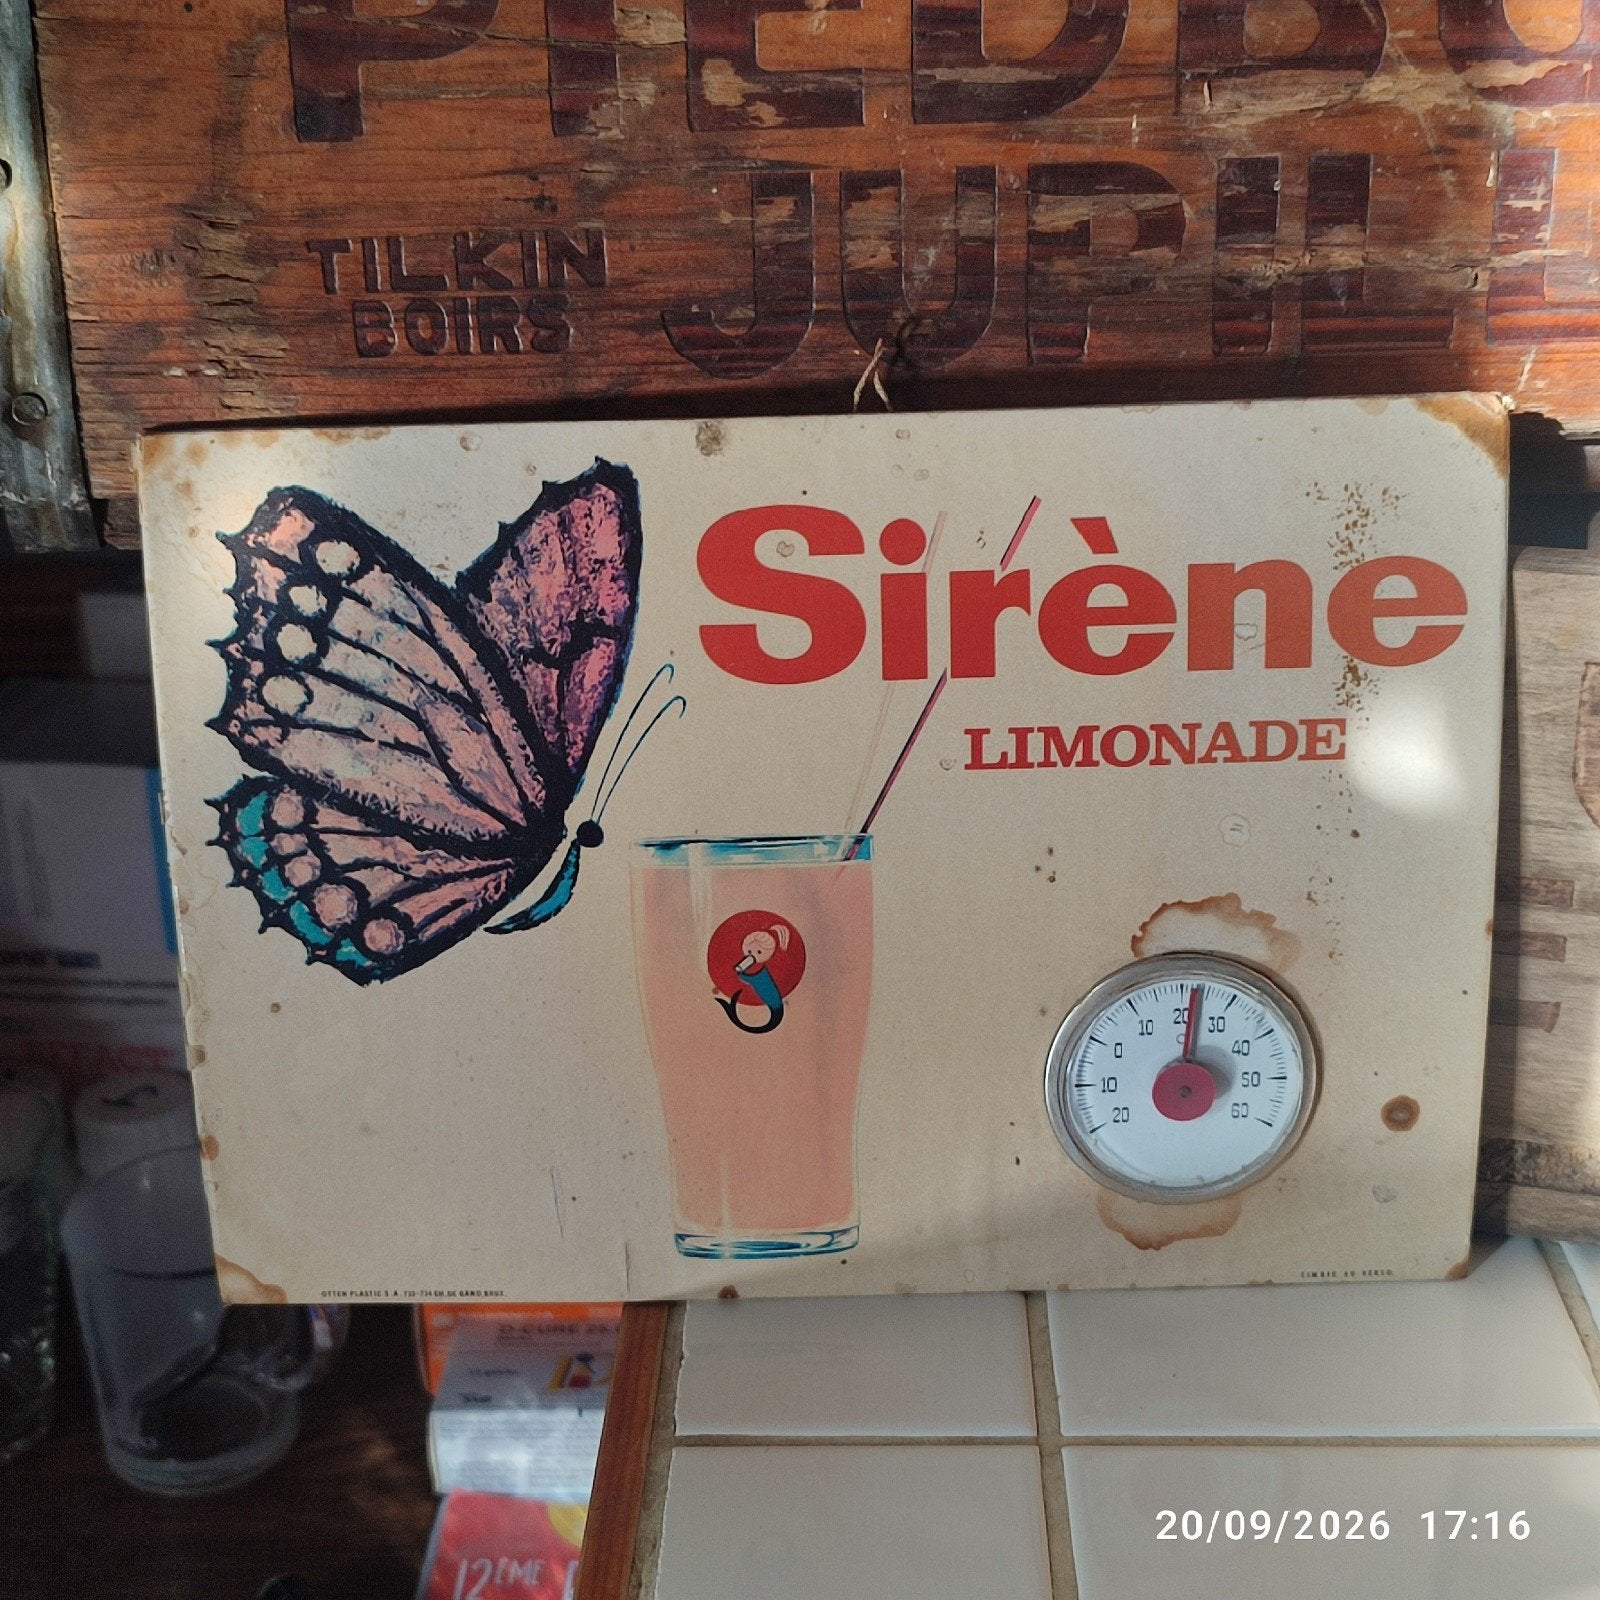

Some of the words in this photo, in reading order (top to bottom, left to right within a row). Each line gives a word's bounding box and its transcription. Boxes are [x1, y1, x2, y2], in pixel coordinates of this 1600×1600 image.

[307, 228, 607, 295] TILKIN
[353, 295, 574, 358] BOIRS
[696, 504, 1467, 685] Sirène
[963, 718, 1347, 771] LIMONADE
[1139, 1020, 1154, 1036] 10
[1208, 1016, 1226, 1033] 30
[1114, 1042, 1123, 1058] 0
[1232, 1039, 1250, 1056] 40
[1101, 1077, 1118, 1093] 10
[1241, 1071, 1261, 1087] 50
[1112, 1107, 1130, 1123] 20
[1231, 1102, 1249, 1118] 60
